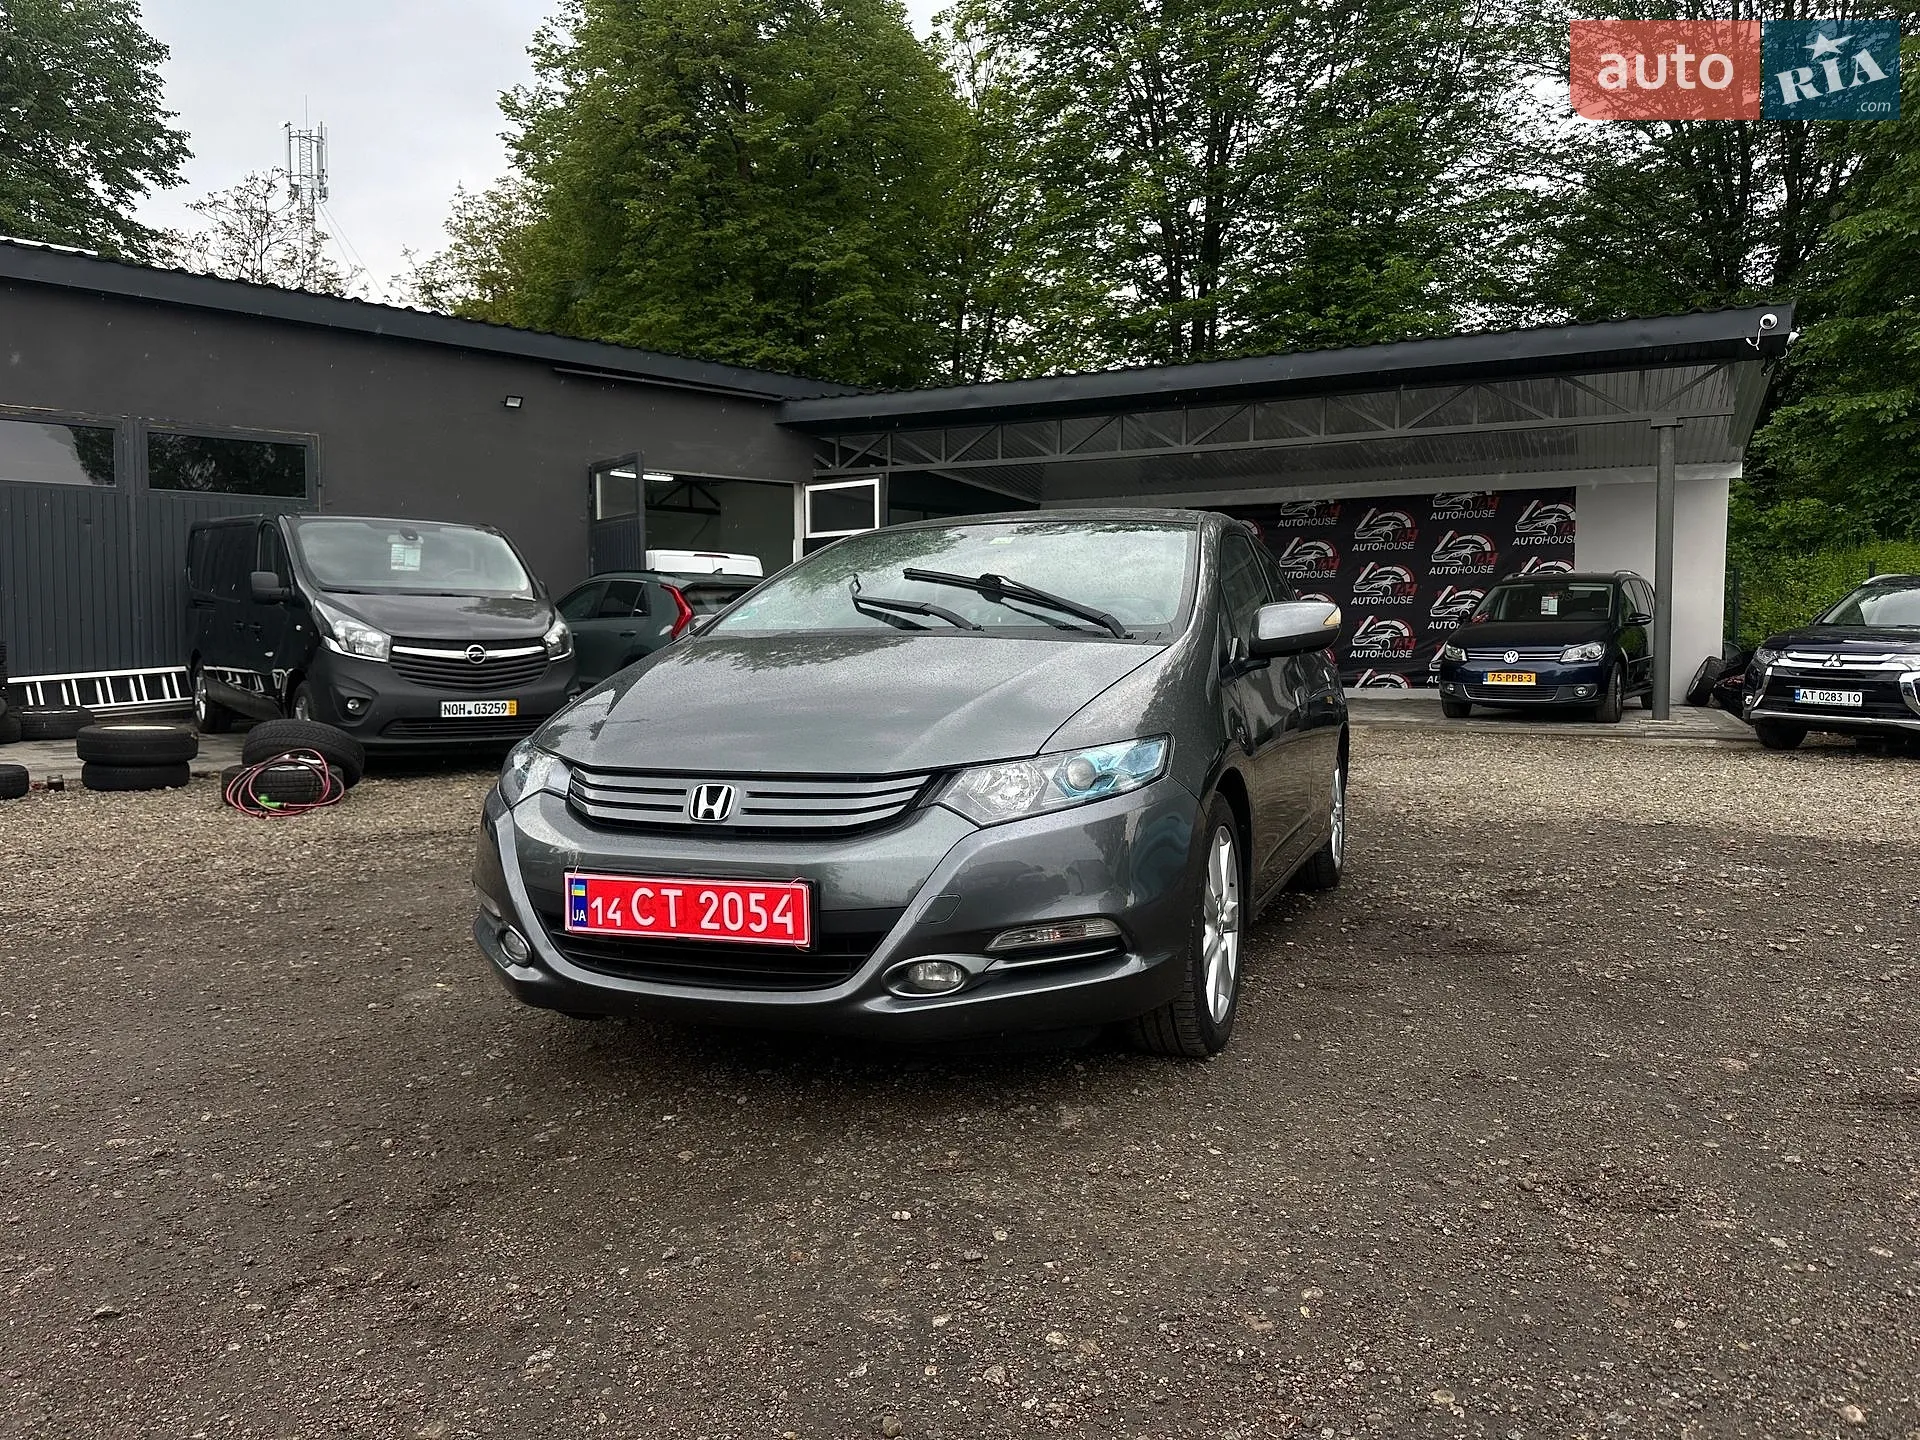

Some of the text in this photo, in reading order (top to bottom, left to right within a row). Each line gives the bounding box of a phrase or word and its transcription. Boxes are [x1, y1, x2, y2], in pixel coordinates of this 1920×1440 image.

[1429, 509, 1496, 521] AUTOHOUSE
[1277, 517, 1337, 528] AUTOHOUSE
[1352, 541, 1415, 552] AUTOHOUSE
[1284, 570, 1337, 579] UTOHOUSE
[1428, 565, 1495, 575] AUTOHOUSE
[1350, 595, 1414, 605] AUTOHOUSE
[1427, 620, 1460, 630] AUTO
[1349, 649, 1413, 659] AUTOHOUSE
[1491, 673, 1532, 683] 75-PPB-3
[1801, 690, 1816, 700] AT
[1818, 691, 1843, 702] 0283
[443, 703, 466, 716] NOH
[474, 702, 507, 715] 03259
[572, 908, 586, 922] UA
[590, 887, 796, 935] 14 CT 2054
